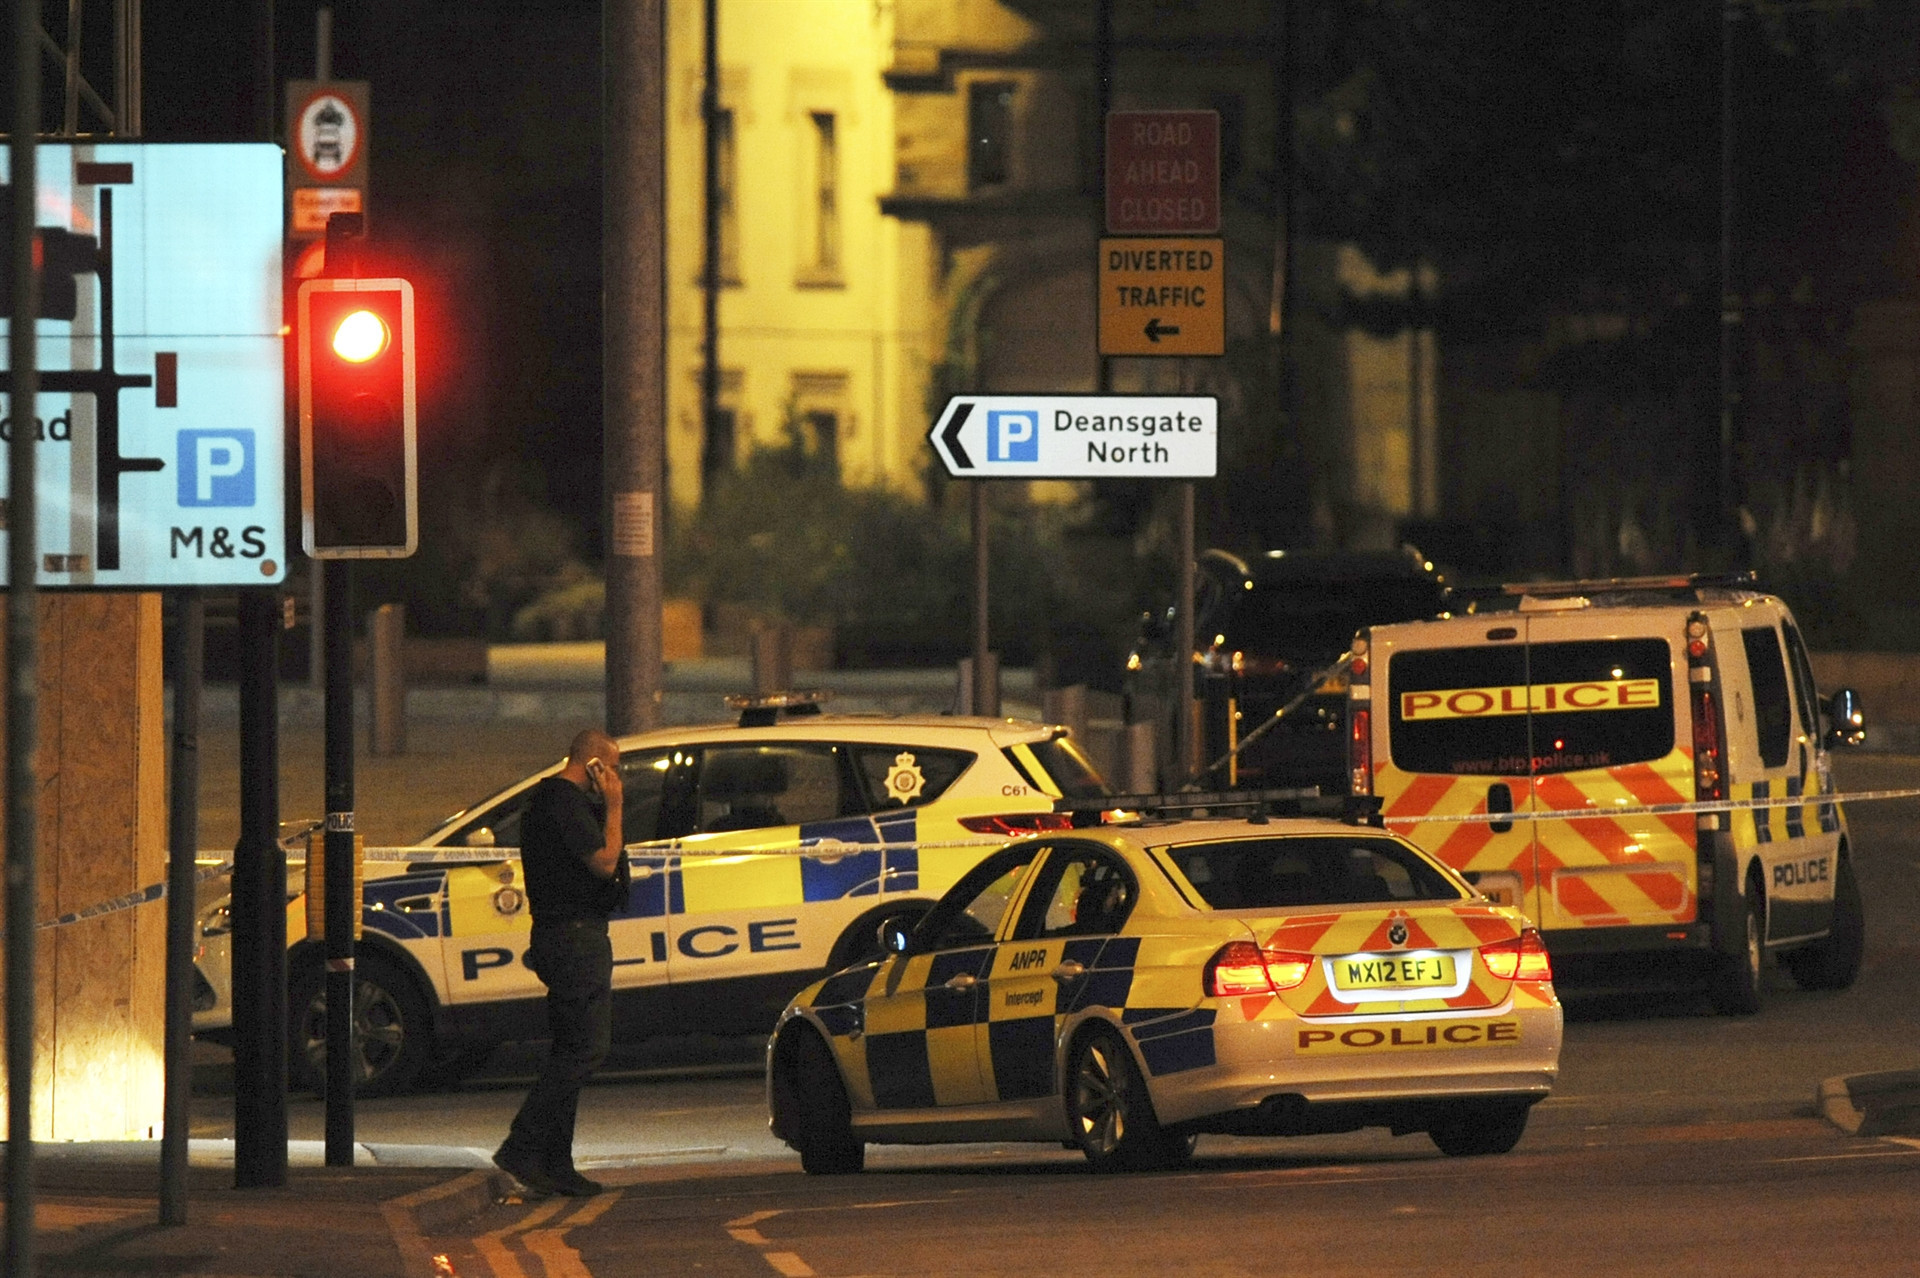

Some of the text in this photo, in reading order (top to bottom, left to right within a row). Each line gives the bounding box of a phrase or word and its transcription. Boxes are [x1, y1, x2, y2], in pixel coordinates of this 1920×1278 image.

[1134, 122, 1193, 146] ROAD
[1125, 160, 1200, 184] AHEAD
[1120, 200, 1205, 222] CLOSED
[1109, 250, 1214, 272] DIVERTED
[1116, 286, 1206, 307] TRAFFIC
[1054, 410, 1203, 436] Deansgate
[999, 414, 1033, 460] P
[1087, 441, 1169, 463] North
[196, 437, 245, 500] P
[170, 525, 266, 559] M&S
[1403, 681, 1657, 718] POLICE
[1001, 785, 1028, 797] C61
[1773, 857, 1828, 888] POLICE
[461, 918, 802, 981] PICE
[1008, 949, 1047, 971] ANPR
[1005, 989, 1044, 1007] Intercept
[1298, 1022, 1518, 1048] POLICE
